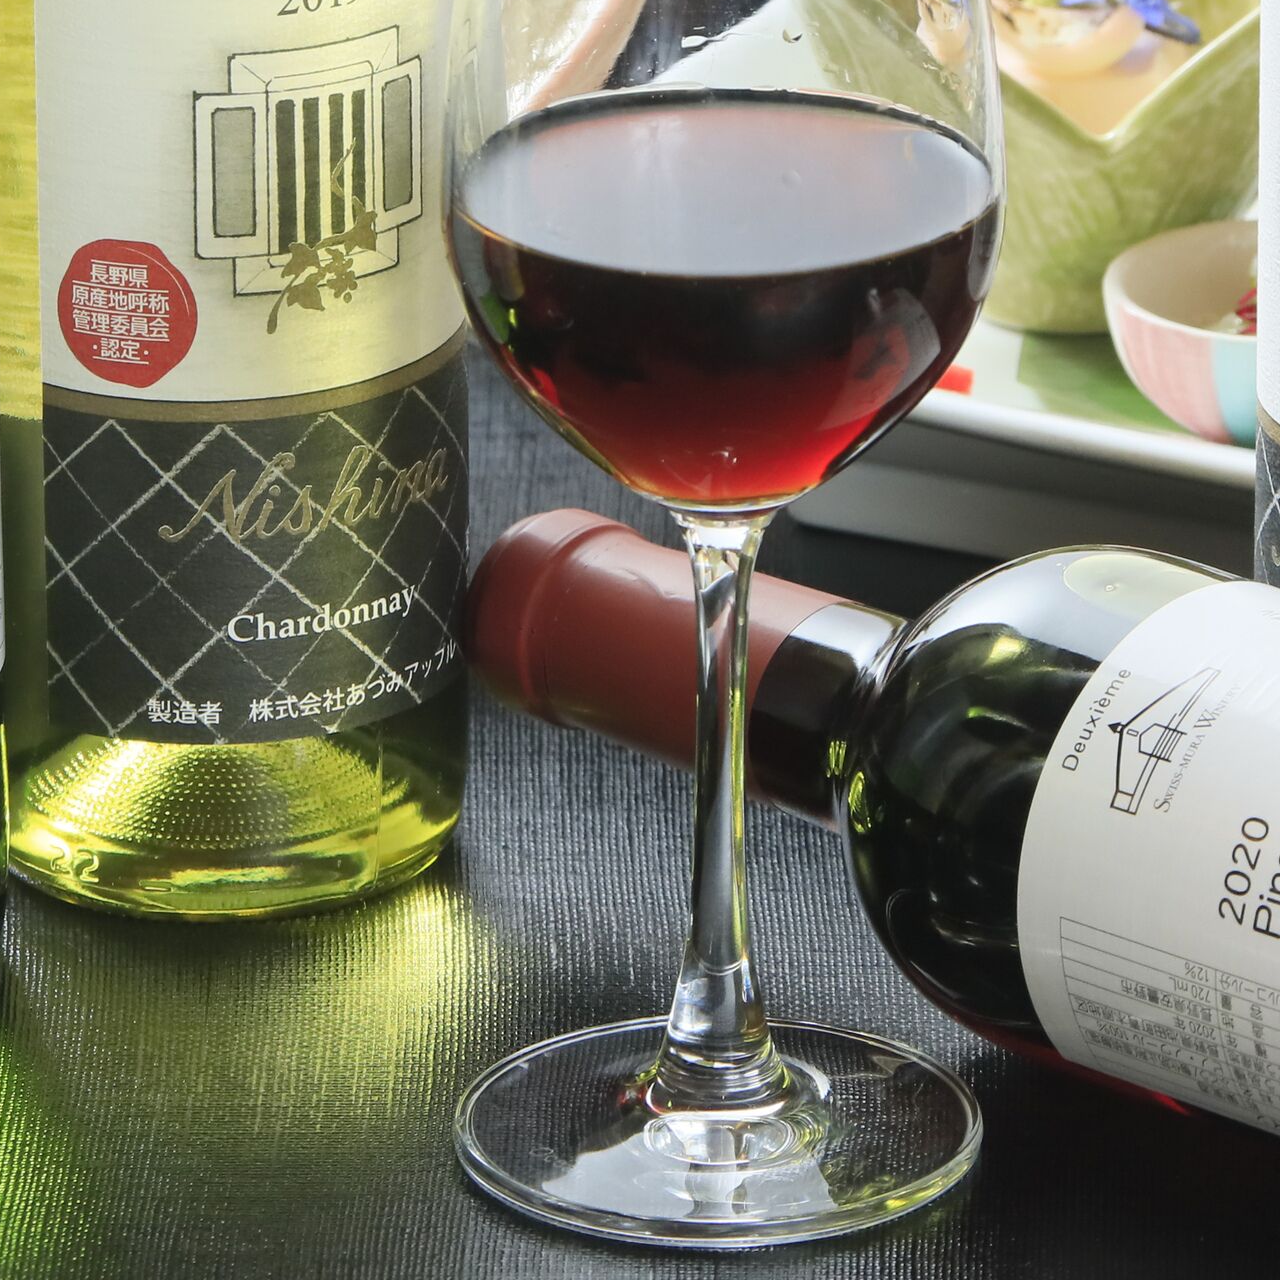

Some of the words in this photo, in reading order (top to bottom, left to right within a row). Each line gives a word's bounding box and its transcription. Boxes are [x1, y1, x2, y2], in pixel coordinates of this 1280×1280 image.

[90, 264, 149, 288] 長野県
[71, 284, 170, 314] 原産地呼称
[72, 309, 170, 337] 管理委員会
[158, 445, 449, 543] Nishina
[227, 584, 418, 644] Chardonnay
[147, 700, 222, 725] 製造者
[1061, 668, 1131, 772] Deuxième
[1218, 816, 1270, 926] 2020
